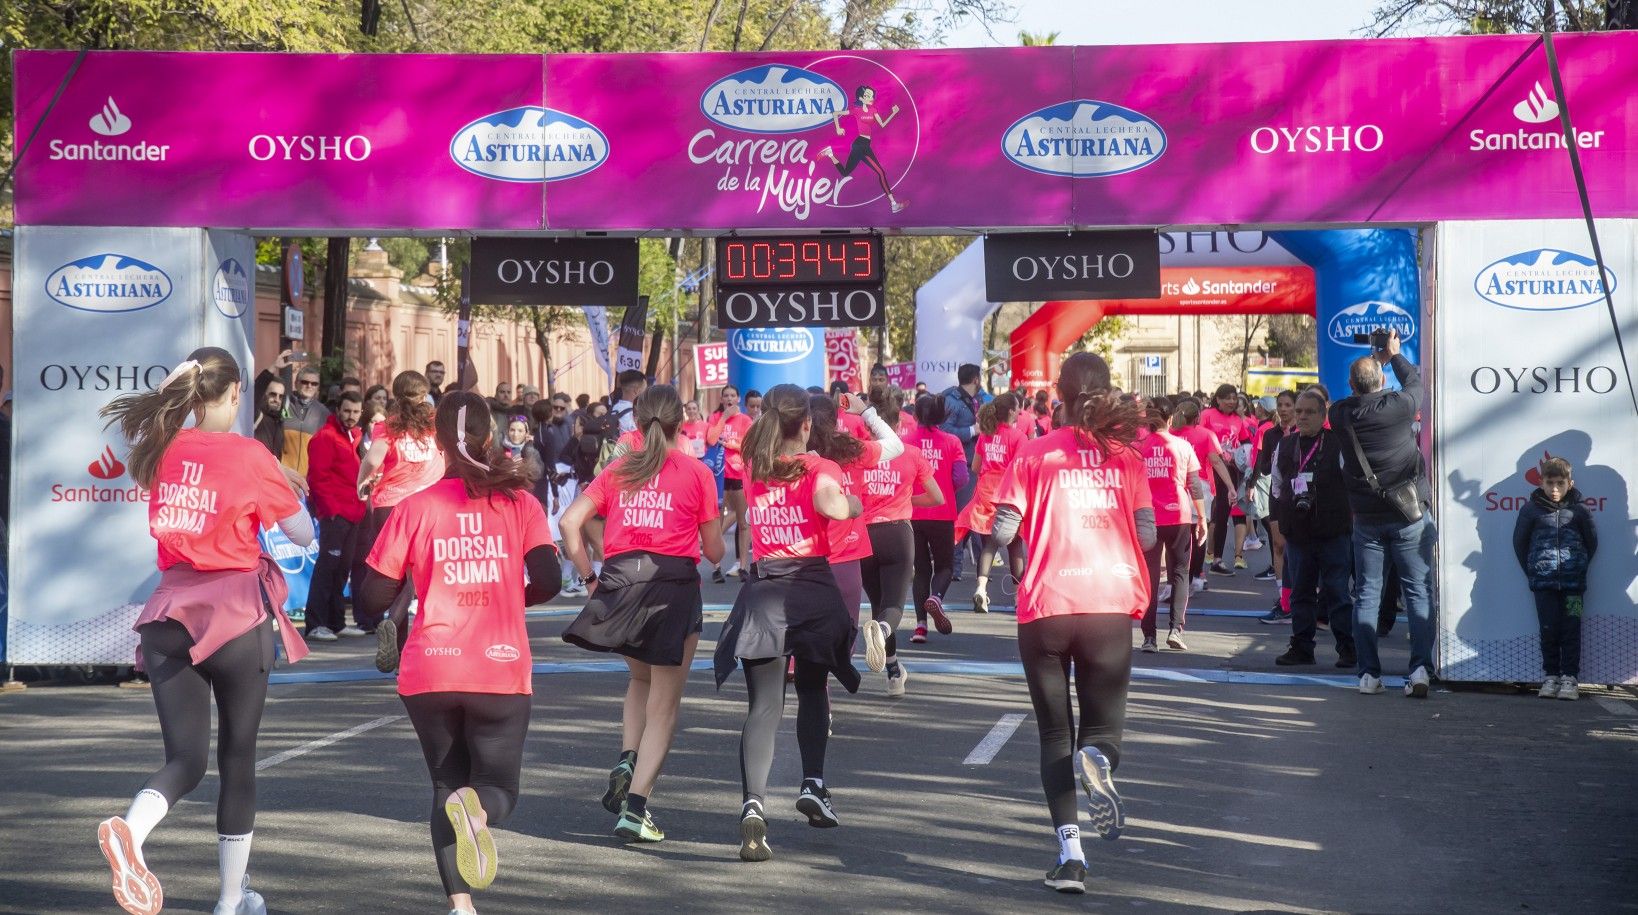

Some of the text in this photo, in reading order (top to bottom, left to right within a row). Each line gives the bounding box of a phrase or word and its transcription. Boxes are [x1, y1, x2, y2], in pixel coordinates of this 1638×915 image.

[734, 87, 832, 95] CENTRAL LECHERA
[712, 90, 836, 116] ASTURIANA
[1039, 126, 1149, 134] CENTRAL LECHERA
[1250, 124, 1384, 154] OYSHO
[50, 139, 170, 162] Santander
[248, 134, 372, 162] OYSHO
[463, 134, 598, 162] ASTURIANA
[687, 128, 809, 165] Carrera
[1014, 128, 1155, 157] ASTURIANA
[716, 161, 854, 221] de la Mujer
[497, 258, 615, 286] OYSHO
[1012, 252, 1134, 281] OYSHO
[55, 275, 164, 298] ASTURIANA
[1202, 279, 1277, 295] Santander
[725, 289, 877, 324] OYSHO
[736, 333, 809, 352] ASTURIANA
[1470, 365, 1618, 395] OYSHO
[921, 439, 933, 449] TU
[1152, 446, 1164, 457] TU
[1077, 449, 1102, 468] TU
[182, 460, 204, 485] TU
[864, 469, 901, 485] DORSAL
[1059, 468, 1123, 489] DORSAL
[1147, 467, 1170, 479] SUMA
[51, 484, 151, 503] Santande
[158, 482, 218, 514] DORSAL
[767, 486, 786, 506] TU
[868, 482, 896, 497] SUMA
[1066, 489, 1119, 510] SUMA
[158, 505, 206, 535] SUMA
[456, 512, 482, 535] TU
[622, 508, 664, 530] SUMA
[752, 505, 808, 527] DORSAL
[1081, 515, 1110, 530] 2025
[760, 525, 804, 546] SUMA
[433, 535, 508, 562] DORSAL
[443, 561, 499, 585] SUMA
[456, 590, 490, 608] 2025
[424, 647, 462, 657] OYSHO
